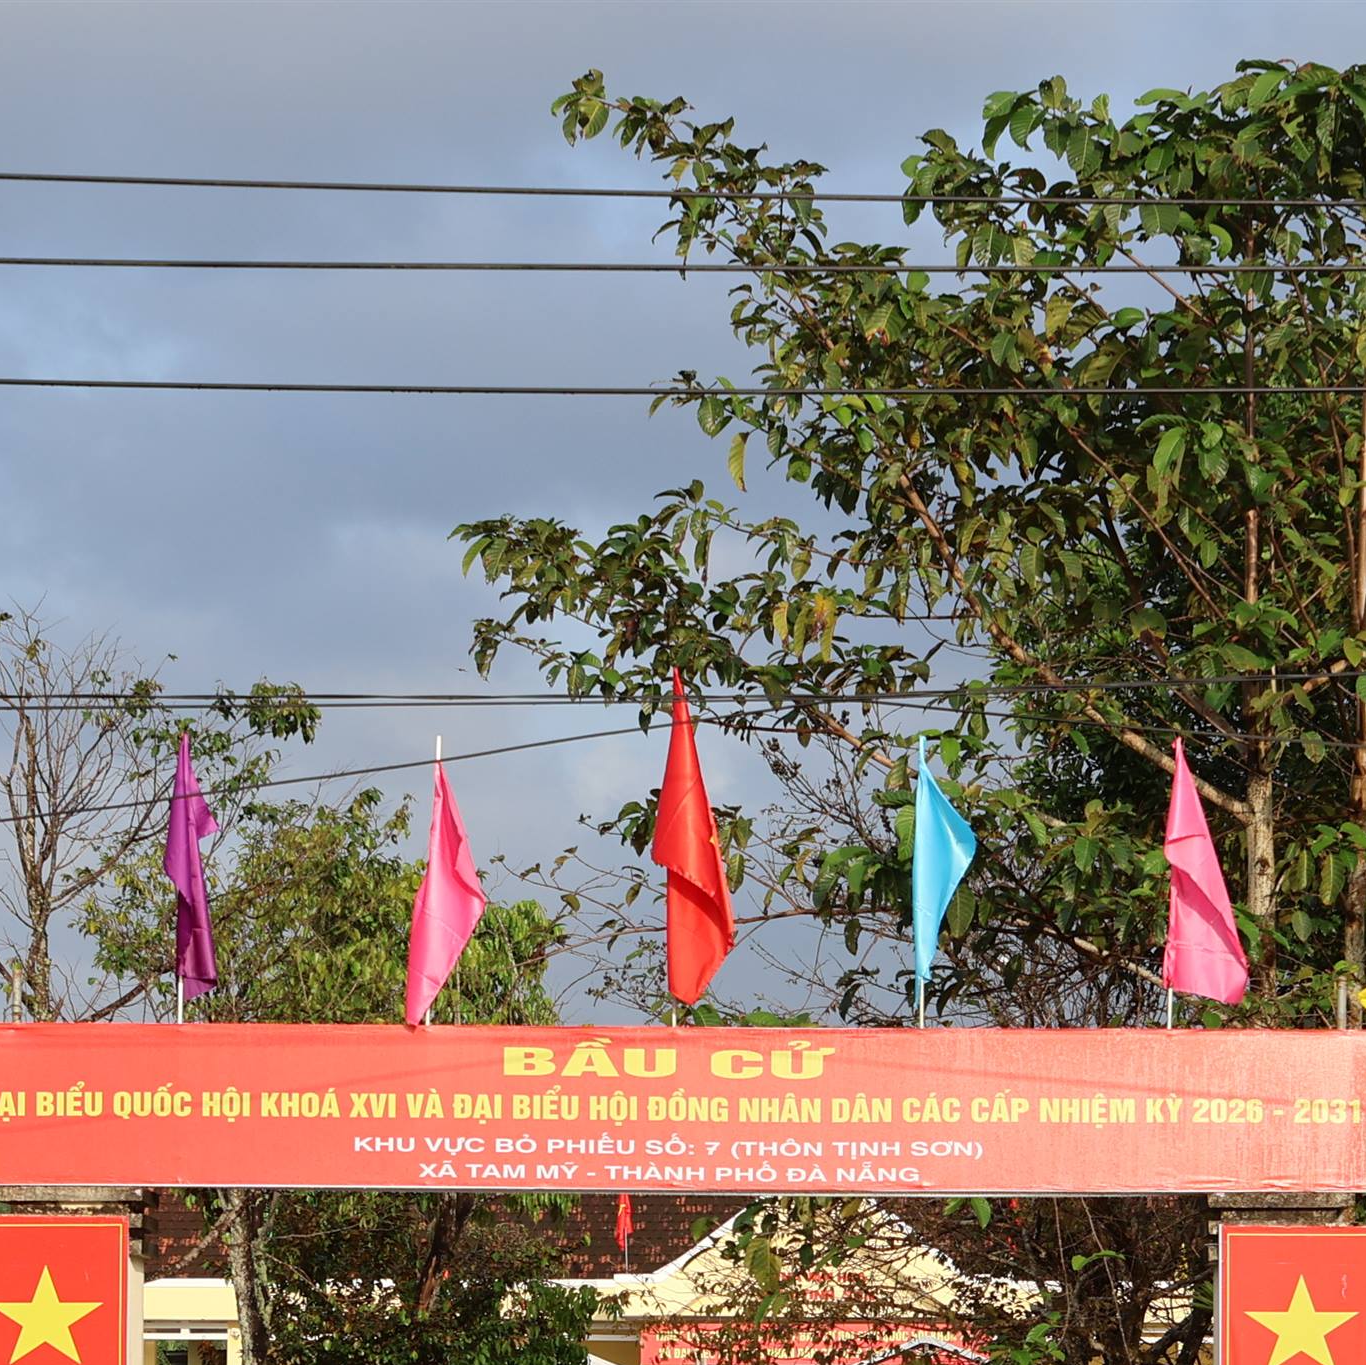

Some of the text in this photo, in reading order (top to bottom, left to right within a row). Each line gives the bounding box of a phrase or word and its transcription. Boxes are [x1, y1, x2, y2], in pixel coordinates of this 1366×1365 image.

[503, 1037, 836, 1080] BẦU CỬ
[36, 1081, 103, 1117] BIỂU
[113, 1083, 192, 1119] QUỐC
[202, 1087, 251, 1122] HỘI
[261, 1088, 341, 1119] KHOÁ
[350, 1093, 396, 1119] XVI
[406, 1089, 444, 1119] VÀ
[453, 1093, 503, 1124] ĐẠI
[512, 1085, 581, 1121] BIỂU
[589, 1091, 638, 1126] HỘI
[647, 1088, 729, 1123] ĐỒNG
[738, 1093, 822, 1123] NHÂN
[831, 1094, 892, 1124] DÂN
[902, 1094, 960, 1124] CÁC
[971, 1090, 1030, 1124] CẤP
[1039, 1094, 1135, 1128] NHIỆM
[1146, 1093, 1183, 1123] KỲ
[1192, 1098, 1264, 1124] 2026
[1273, 1108, 1284, 1117] -
[1294, 1098, 1362, 1124] 2031
[354, 1132, 984, 1160] KHU VỰC BỎ PHIẾU SỐ: 7 (THÔN TỊNH SƠN)
[419, 1160, 457, 1178] XÃ
[465, 1163, 526, 1179] TAM
[535, 1161, 580, 1180] MỸ
[604, 1161, 705, 1181] THÀNH
[715, 1160, 778, 1182] PHỐ
[785, 1163, 828, 1182] ĐÀ
[836, 1161, 921, 1182] NẴNG
